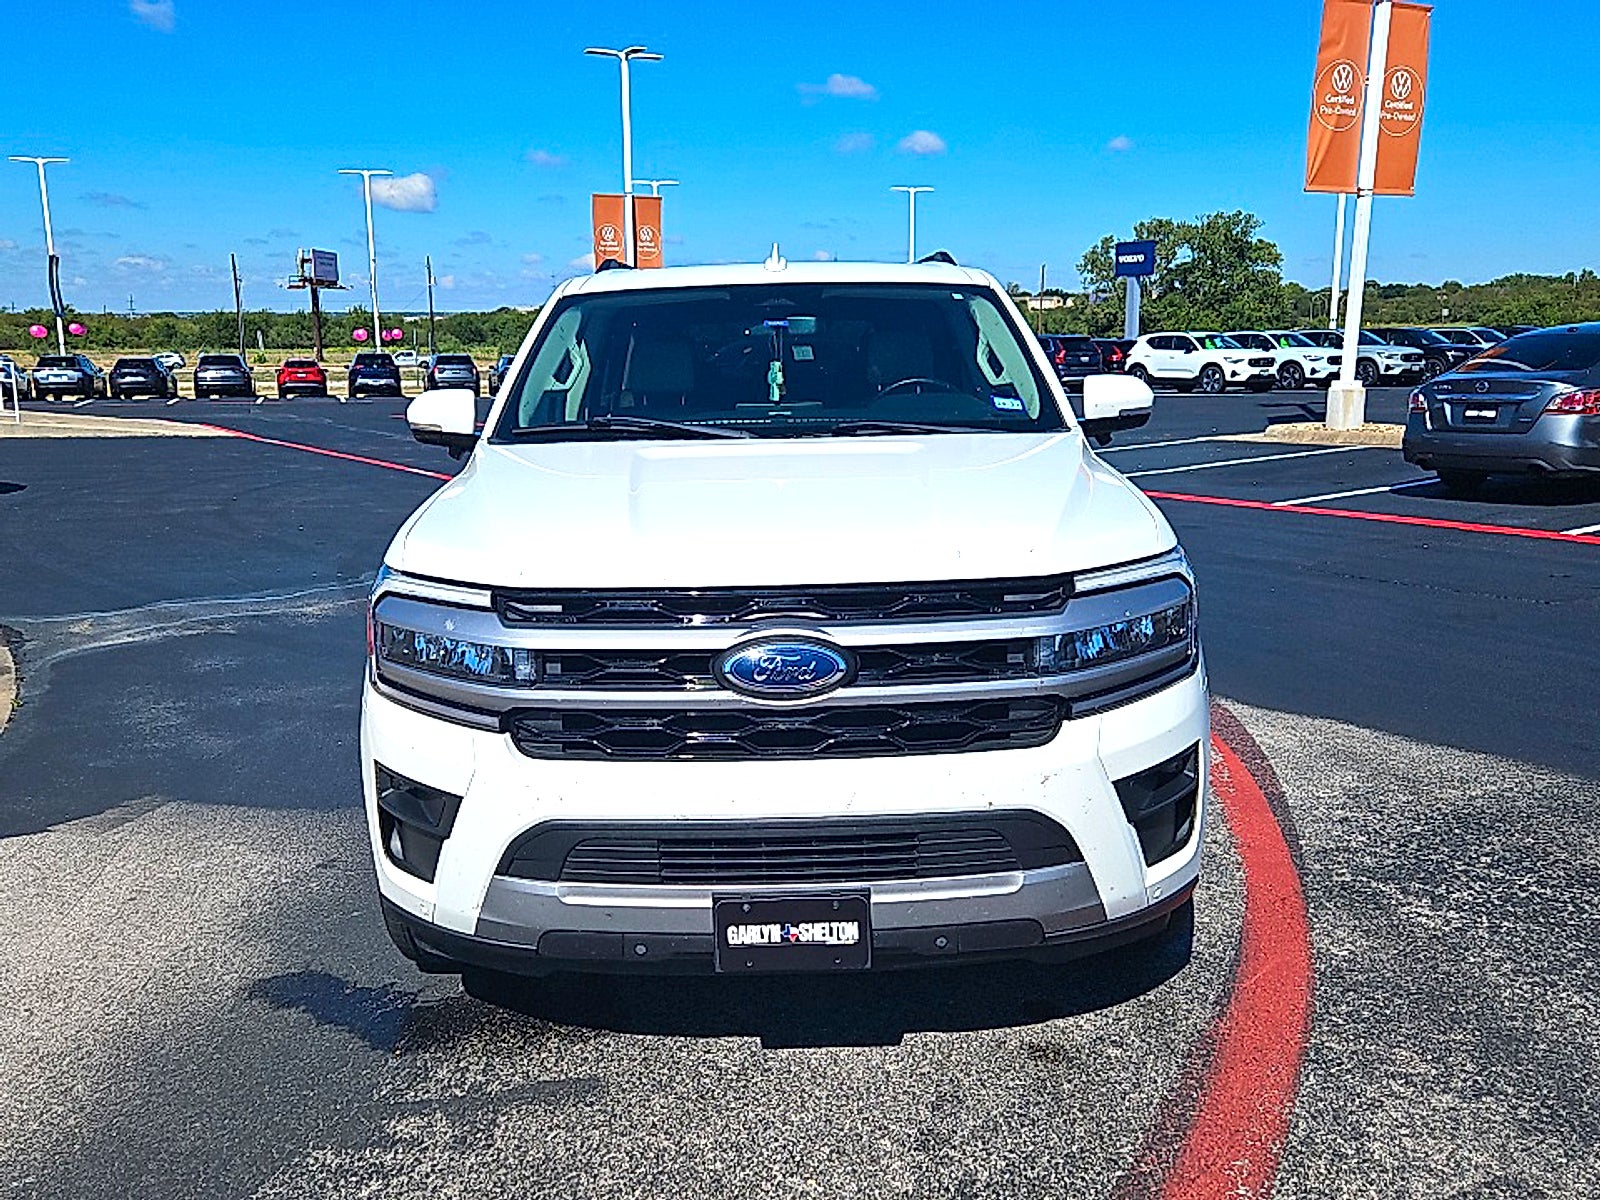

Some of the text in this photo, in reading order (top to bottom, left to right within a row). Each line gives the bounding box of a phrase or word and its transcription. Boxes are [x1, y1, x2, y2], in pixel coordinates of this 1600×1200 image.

[1118, 254, 1145, 263] VOLVO
[753, 656, 817, 682] Ford
[727, 921, 859, 945] GARLYN SHELTON
